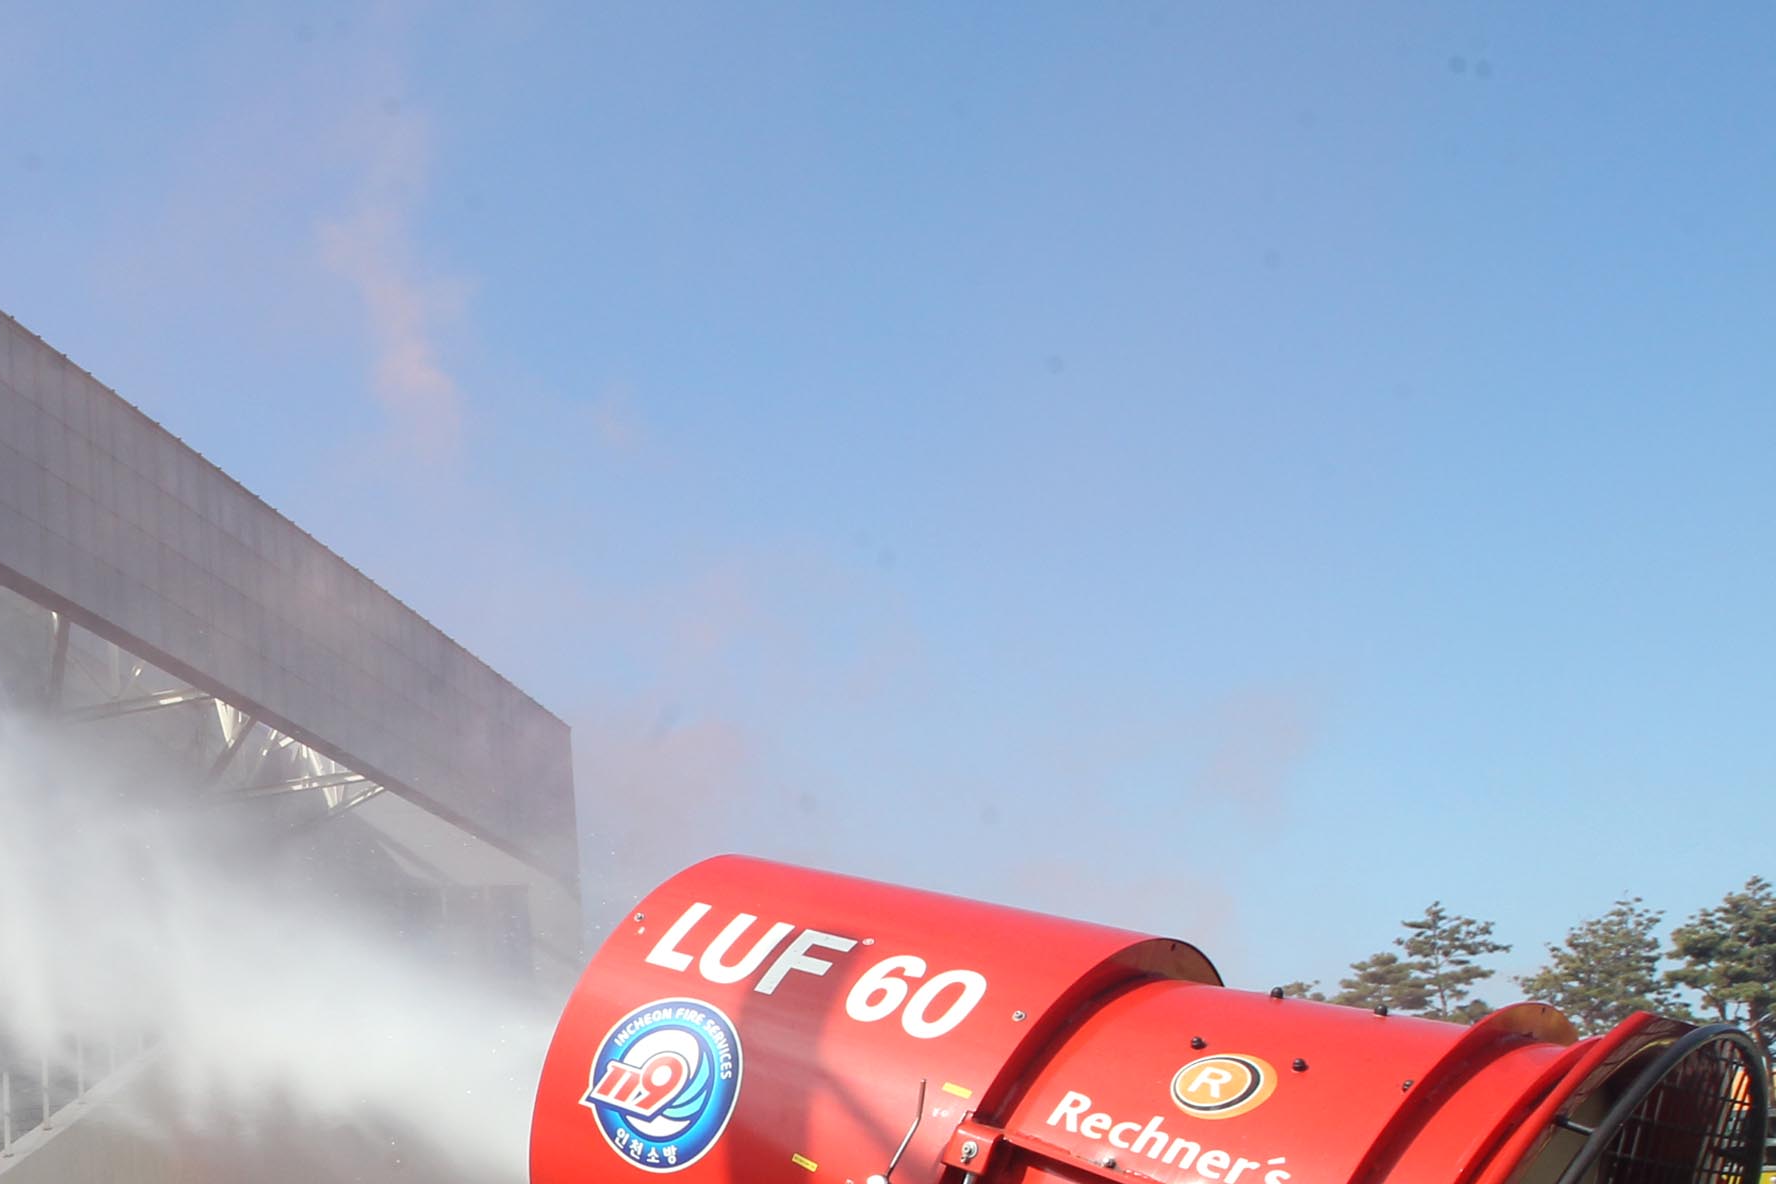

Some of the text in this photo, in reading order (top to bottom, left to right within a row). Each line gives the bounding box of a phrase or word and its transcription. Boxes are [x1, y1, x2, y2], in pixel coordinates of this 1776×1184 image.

[644, 901, 988, 1040] LUF 60
[614, 1007, 733, 1081] INCHEON FIRE SERVICES
[595, 1055, 684, 1111] 119
[1186, 1065, 1234, 1099] R
